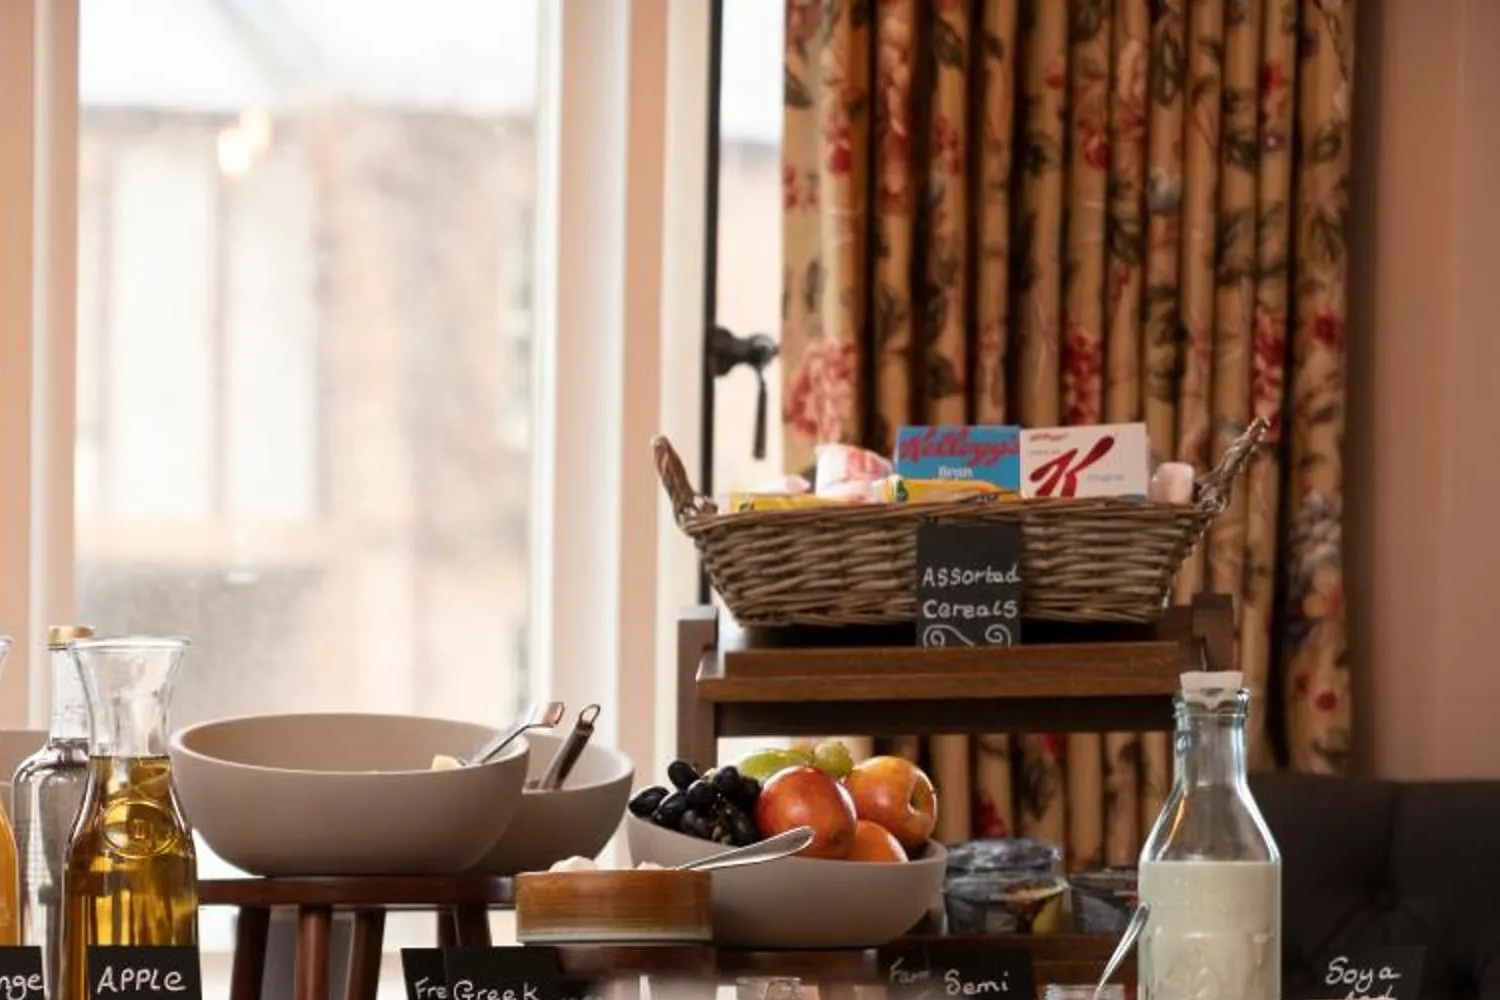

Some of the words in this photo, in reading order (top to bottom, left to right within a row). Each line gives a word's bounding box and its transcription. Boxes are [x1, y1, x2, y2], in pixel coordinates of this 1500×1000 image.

[1030, 435, 1115, 498] K
[414, 976, 448, 1000] Fre
[944, 968, 1010, 996] Semi
[1325, 955, 1402, 993] Soya
